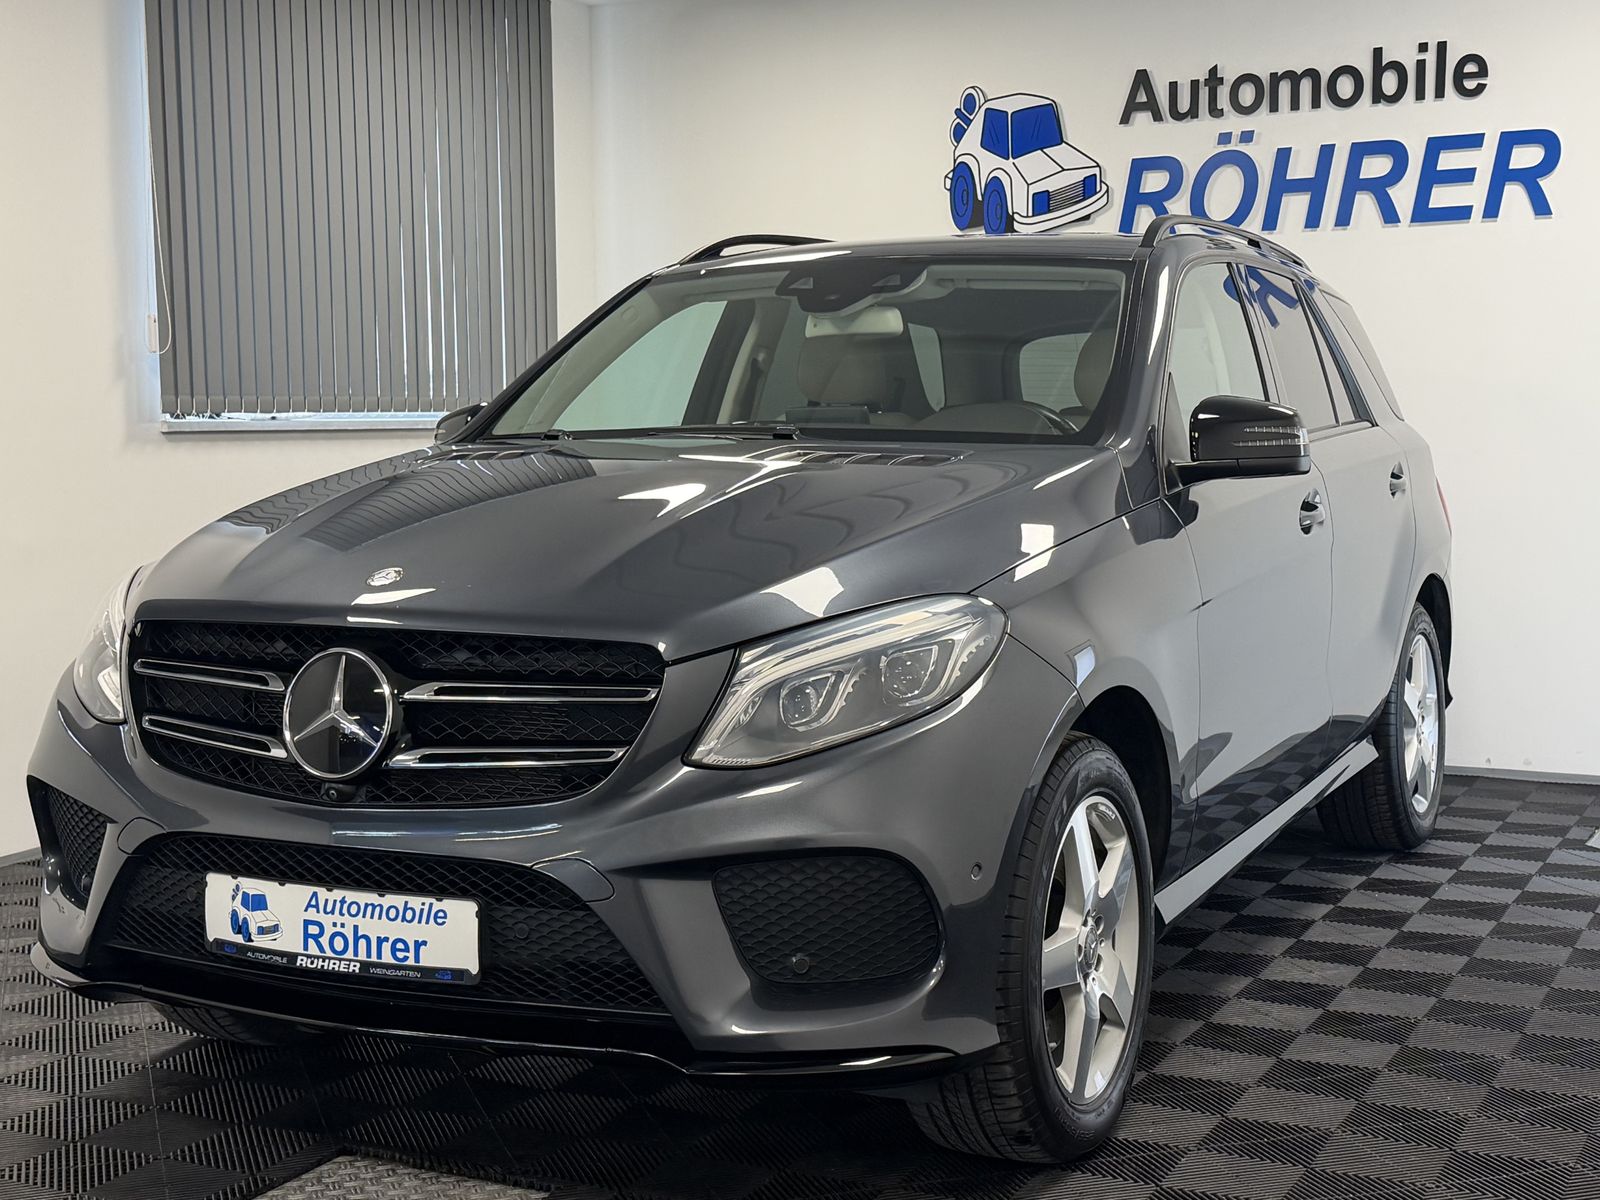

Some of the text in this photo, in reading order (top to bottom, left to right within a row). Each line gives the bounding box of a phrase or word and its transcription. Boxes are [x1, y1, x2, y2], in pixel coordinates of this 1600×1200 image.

[1118, 40, 1489, 126] Automobile
[1118, 128, 1562, 235] RÖHRER
[303, 890, 448, 927] Automobile
[302, 918, 428, 964] Röhrer
[246, 951, 421, 978] AUTOMOBILE RÖHRER WEINGARTEN
